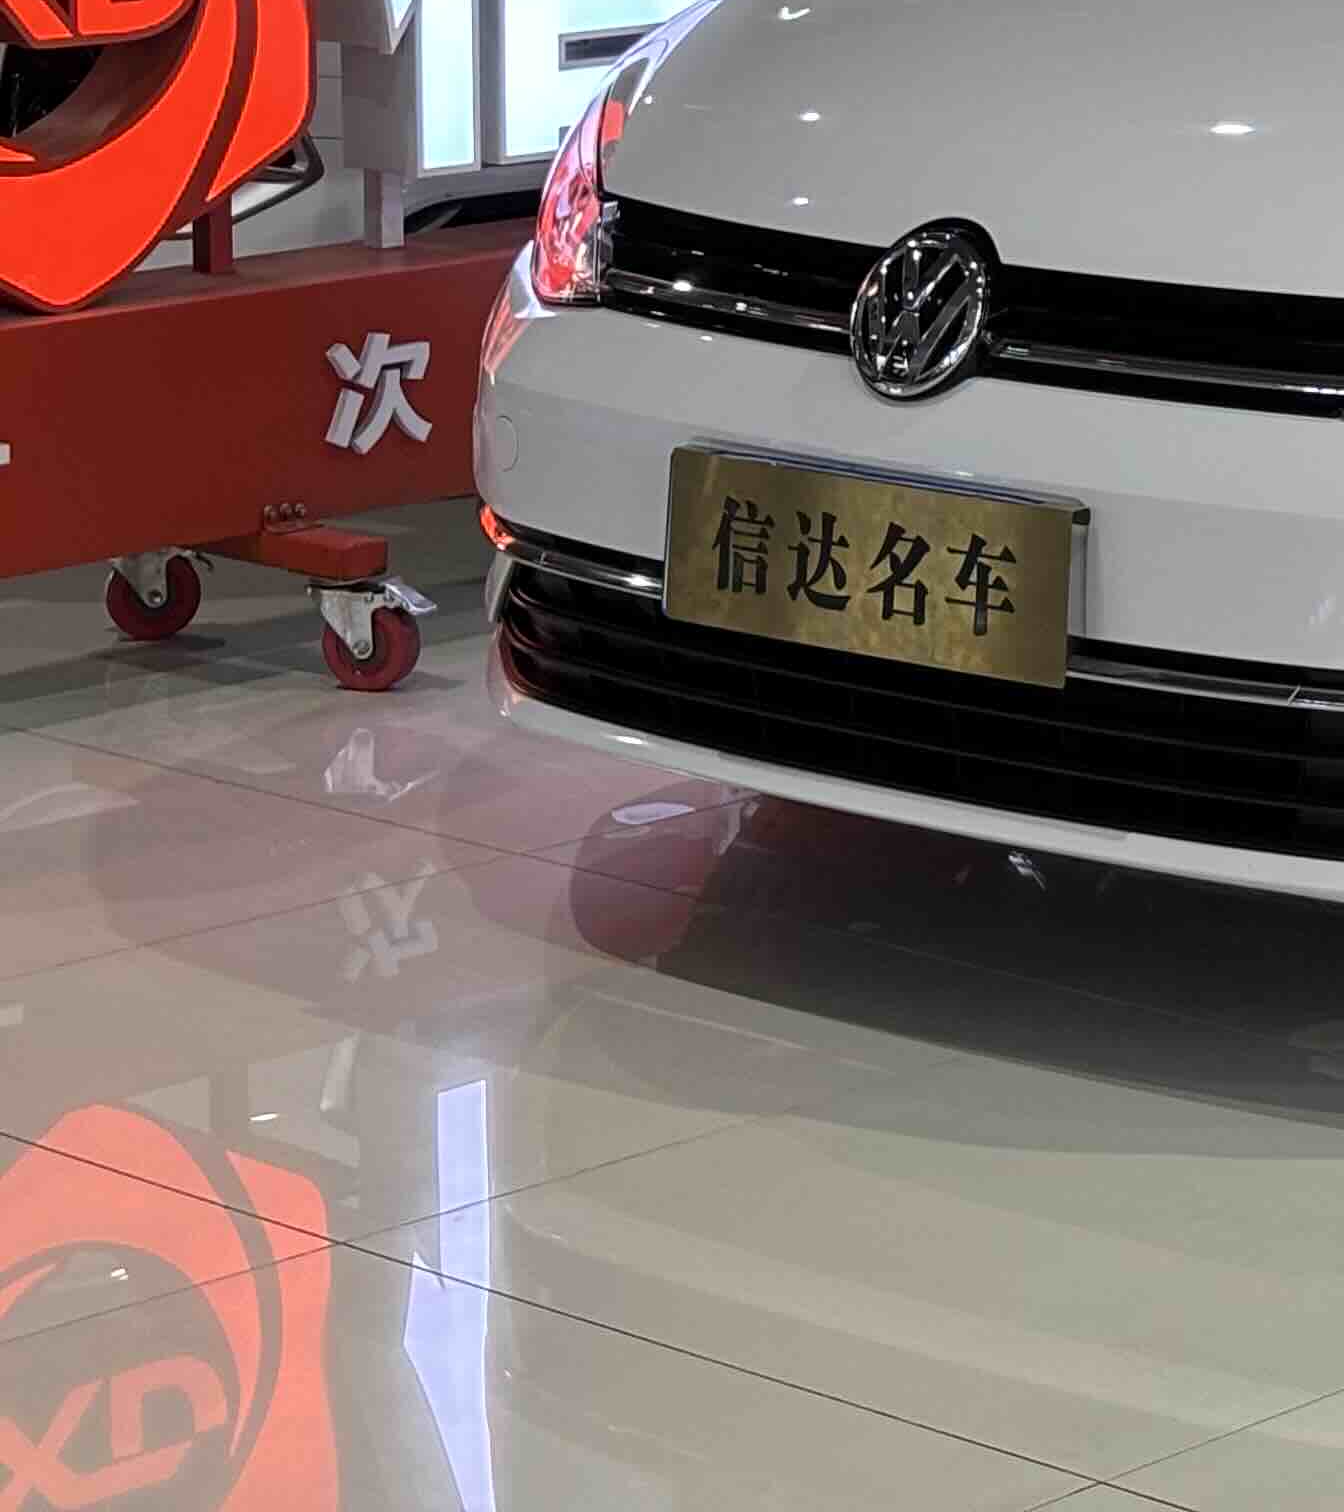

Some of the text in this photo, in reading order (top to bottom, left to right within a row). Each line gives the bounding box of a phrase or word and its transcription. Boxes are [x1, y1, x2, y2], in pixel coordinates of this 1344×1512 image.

[324, 331, 433, 455] 次
[713, 496, 1017, 637] 信达名车
